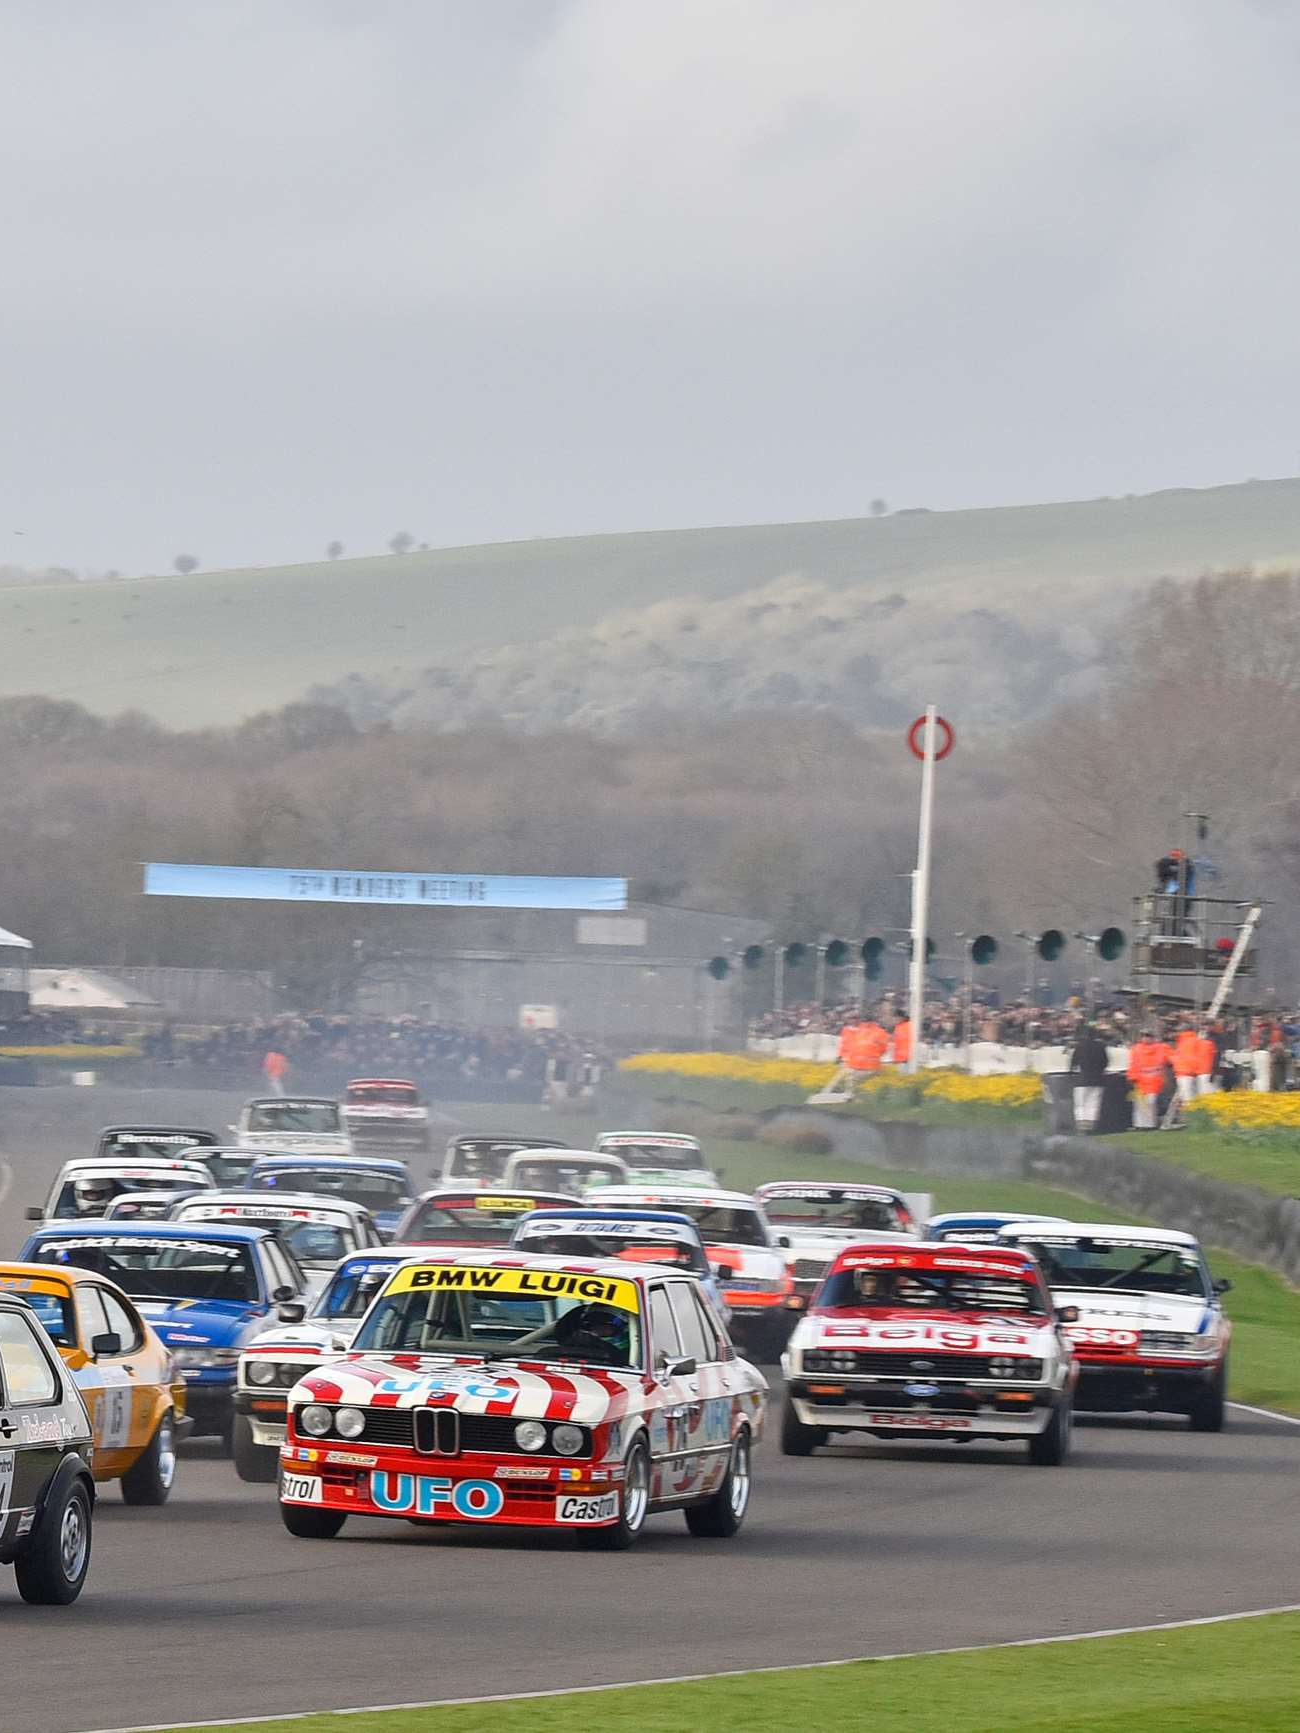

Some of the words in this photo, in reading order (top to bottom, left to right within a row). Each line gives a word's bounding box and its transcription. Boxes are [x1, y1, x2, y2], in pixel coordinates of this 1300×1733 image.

[411, 1269, 502, 1288] BMW
[519, 1272, 619, 1301] LUIGI
[823, 1324, 1028, 1349] Belga
[1064, 1328, 1138, 1345] SSO
[380, 1379, 511, 1399] UFO
[870, 1413, 972, 1429] Belga
[283, 1476, 316, 1499] strol
[371, 1471, 504, 1519] UFO
